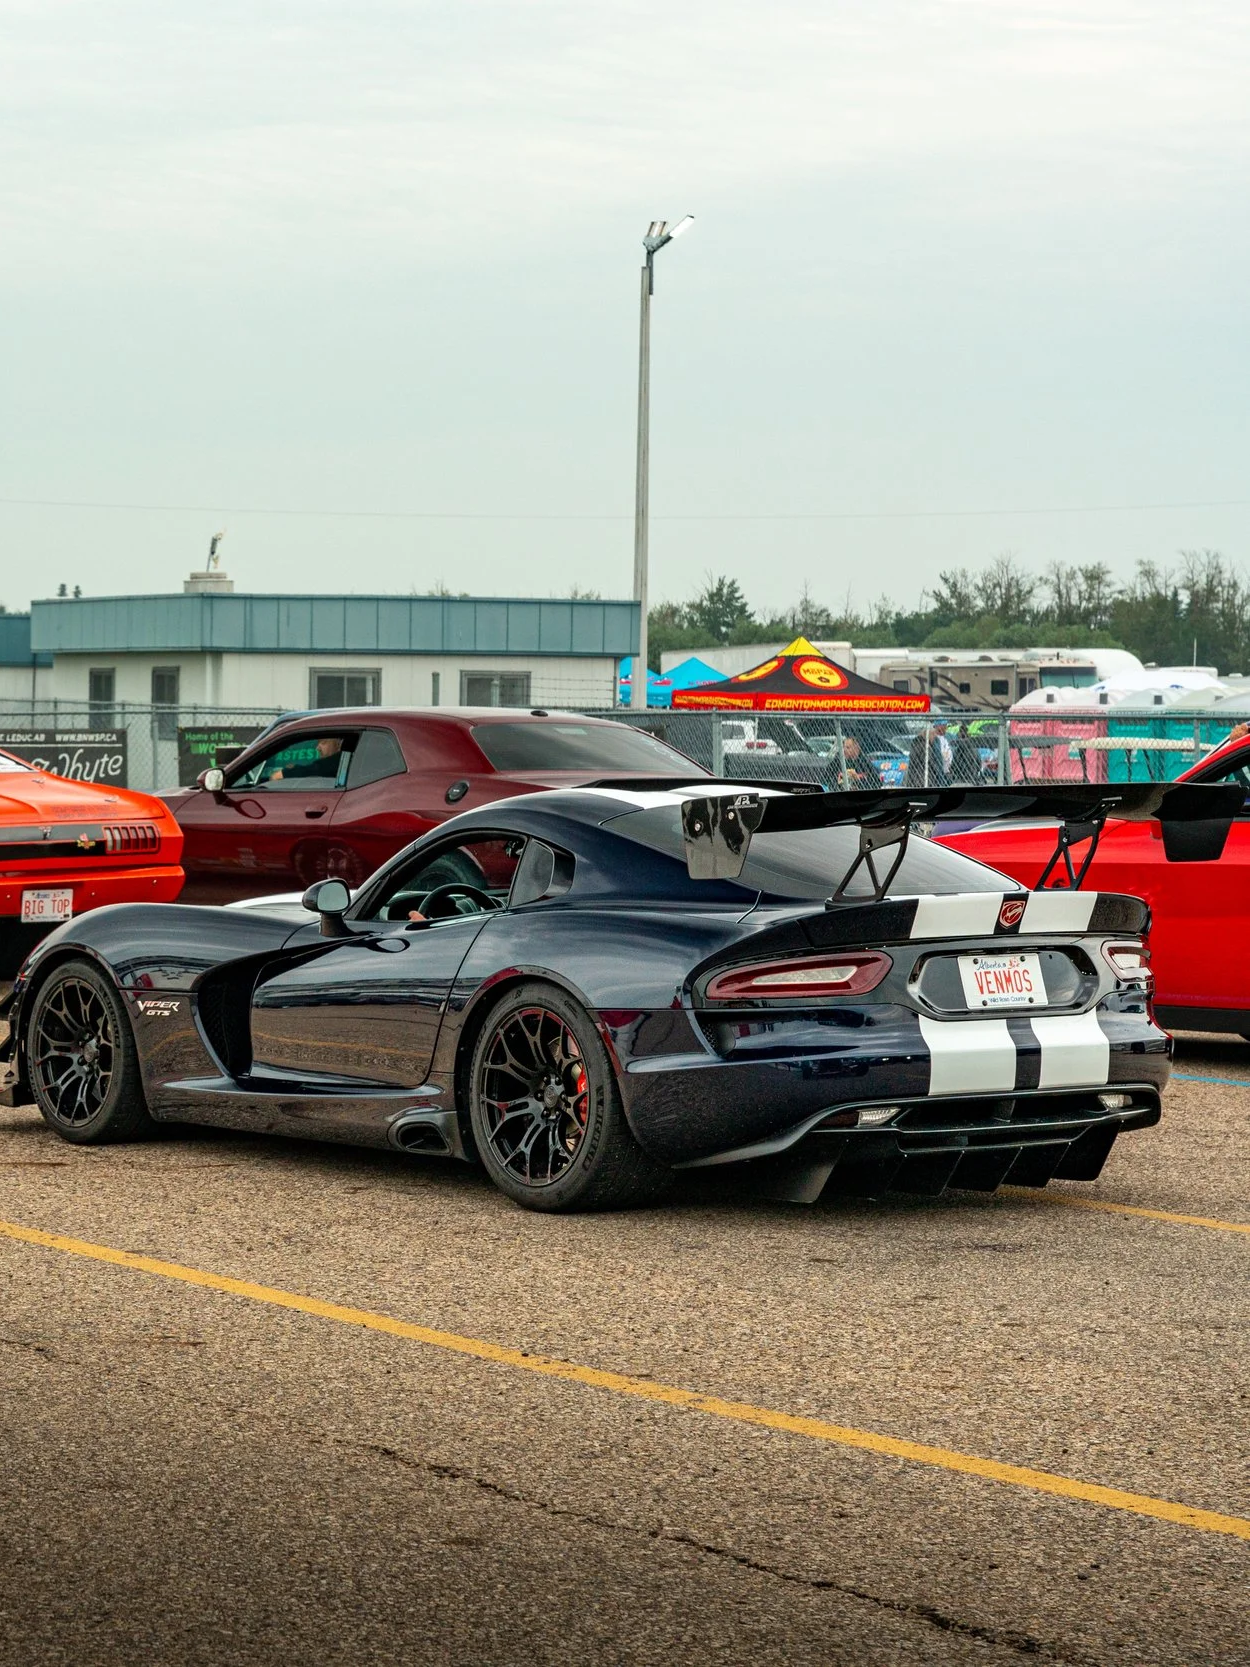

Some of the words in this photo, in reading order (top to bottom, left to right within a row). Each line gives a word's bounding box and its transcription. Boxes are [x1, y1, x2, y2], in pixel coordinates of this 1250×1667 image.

[765, 698, 925, 710] EDMONTONMOPARASSOCIATION.COM
[24, 900, 44, 915] BIG
[52, 899, 70, 914] TOP
[977, 960, 1001, 970] Alberta
[974, 969, 1033, 995] VENMOS
[136, 1000, 180, 1012] VIPER
